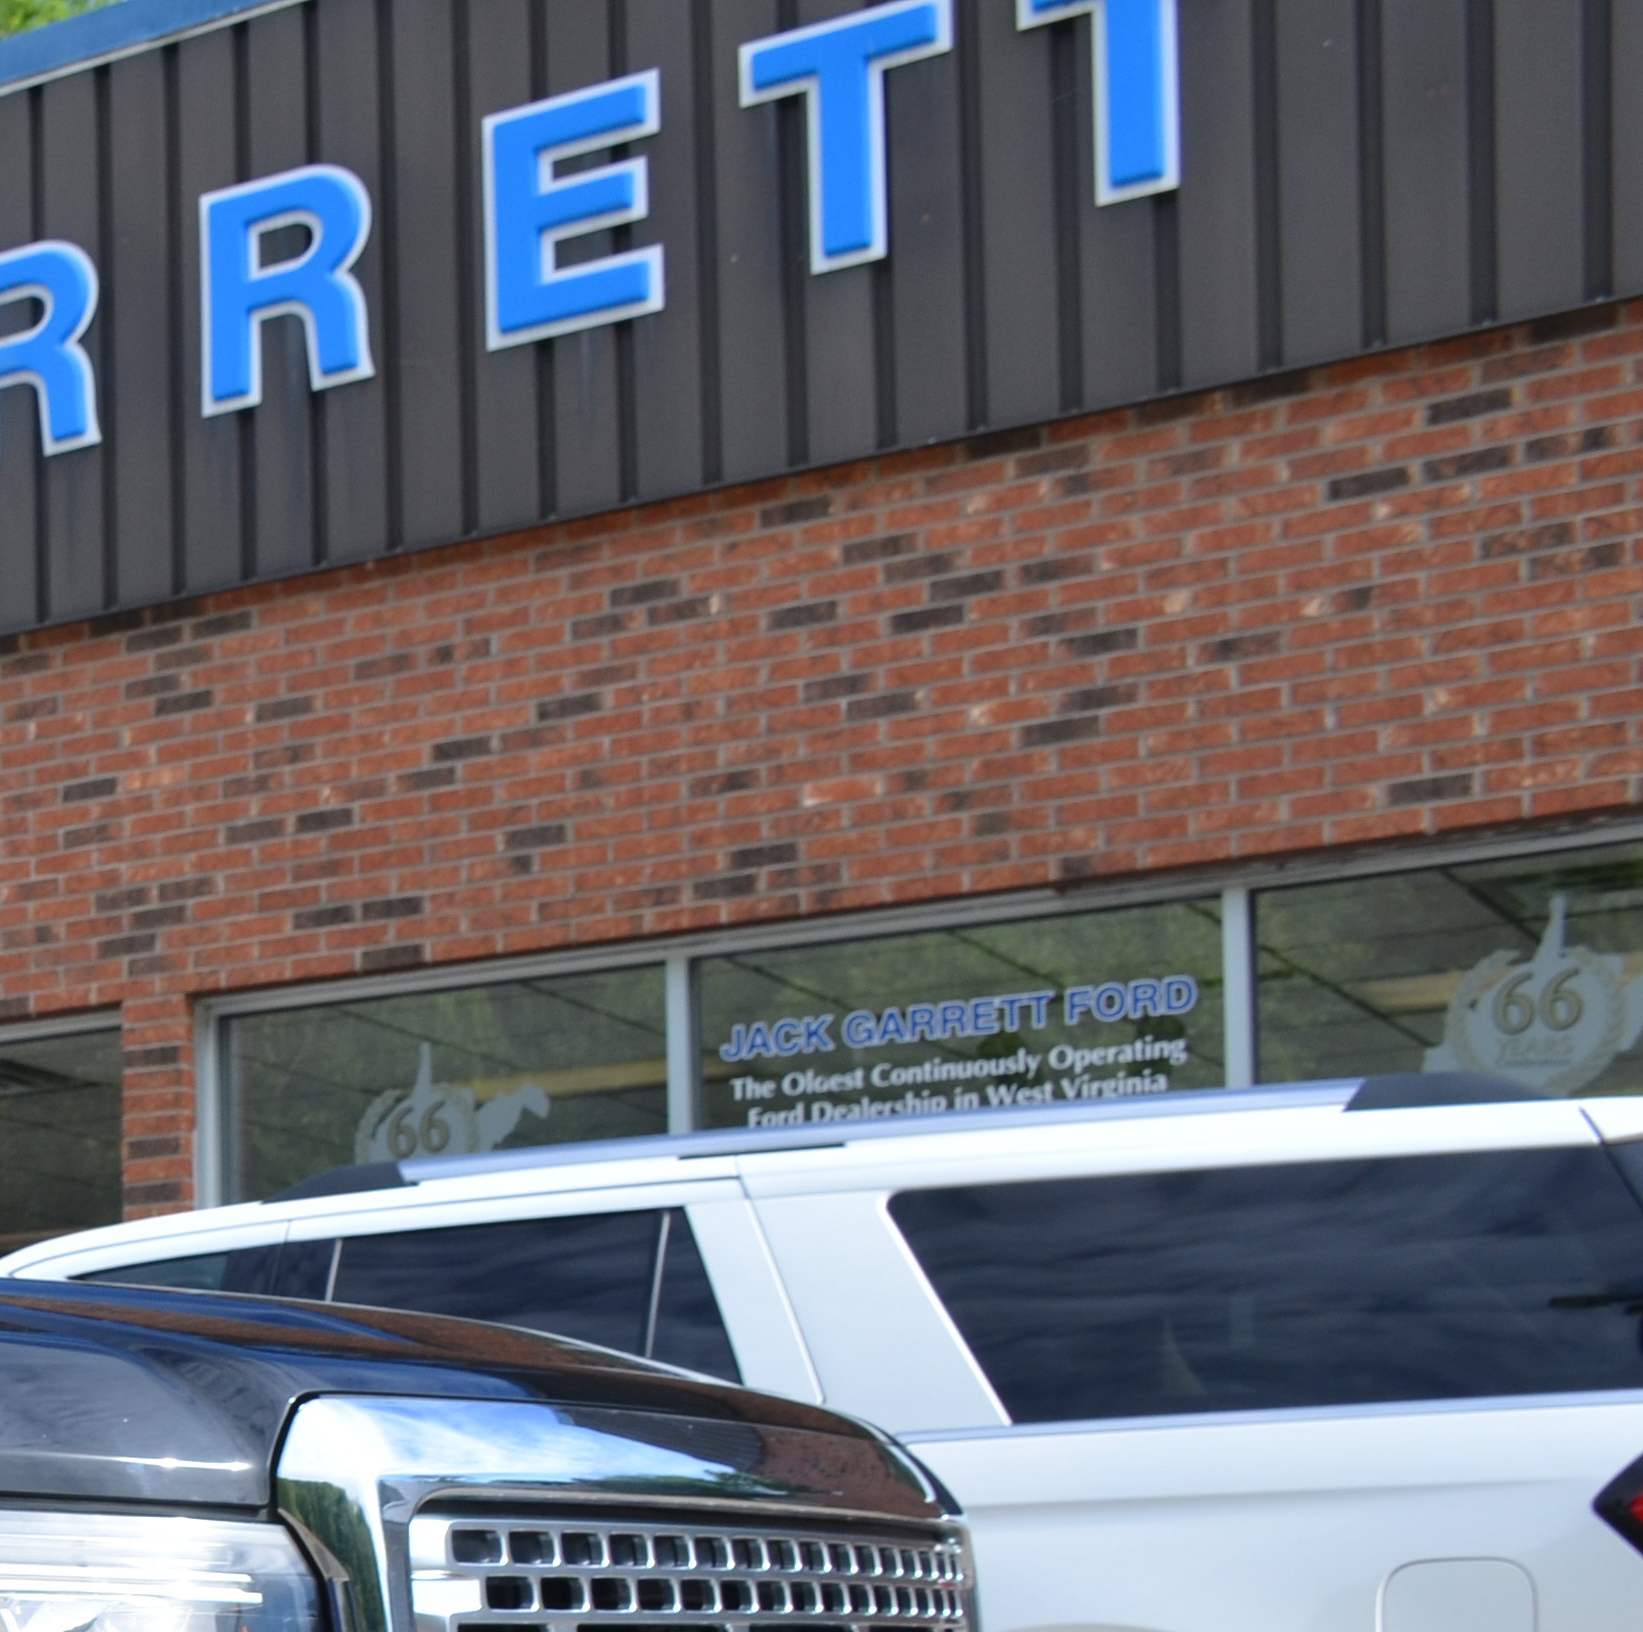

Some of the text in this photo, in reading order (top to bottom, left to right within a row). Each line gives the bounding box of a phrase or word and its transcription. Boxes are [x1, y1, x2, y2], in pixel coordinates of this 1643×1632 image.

[718, 974, 1198, 1064] JACK GARRETT FORD
[1492, 969, 1582, 1034] 66
[729, 1033, 1189, 1103] The Oldest Continuously Operating
[747, 1067, 1169, 1130] Ford Dealership in West Virginia
[387, 1099, 451, 1159] 66
